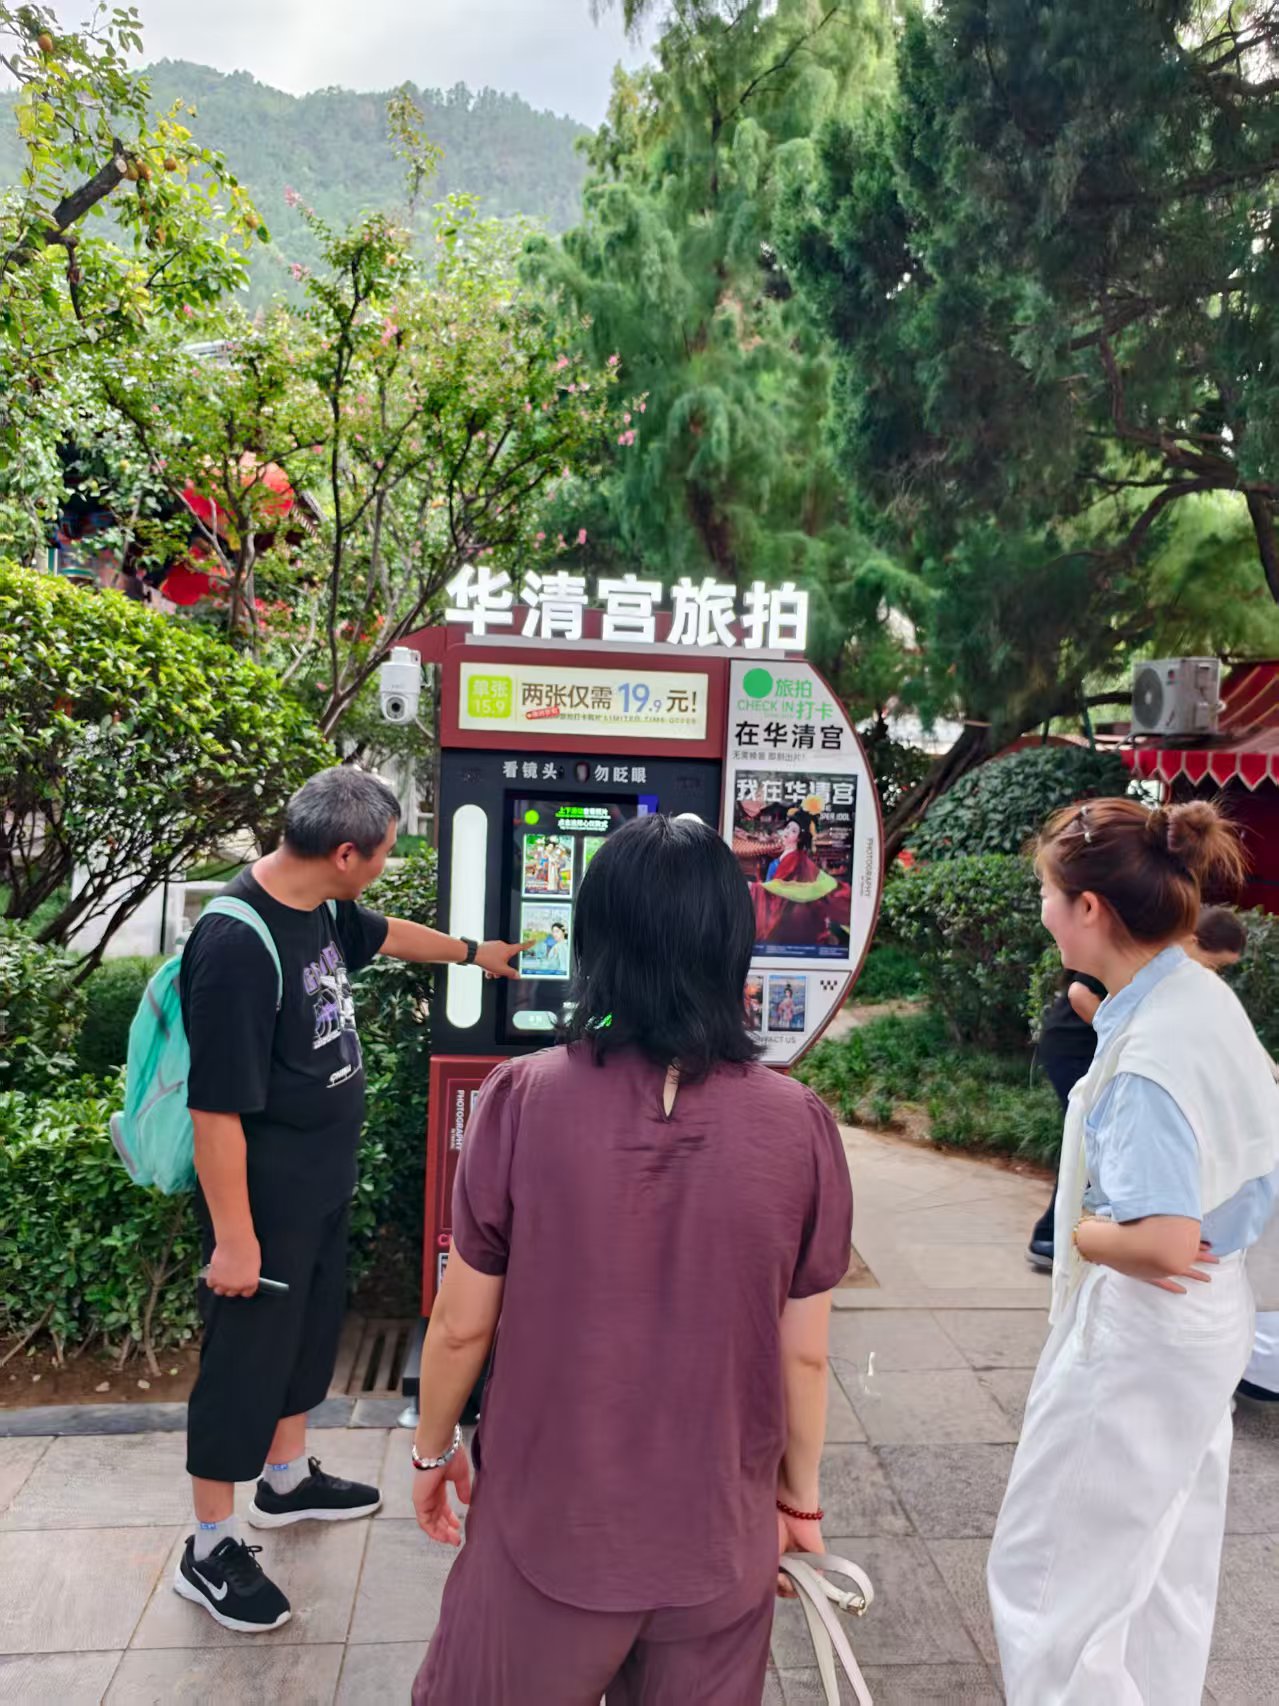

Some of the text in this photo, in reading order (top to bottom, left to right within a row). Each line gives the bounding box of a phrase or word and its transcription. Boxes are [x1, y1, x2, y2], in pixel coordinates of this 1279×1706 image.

[445, 564, 809, 653] 华清宫旅拍
[776, 679, 812, 698] 旅拍
[472, 699, 505, 714] 15.9
[736, 700, 794, 712] CHECK IN
[796, 701, 833, 721] 打卡
[735, 721, 844, 750] 在华清宫
[503, 761, 647, 783] 看镜头 勿眨眼
[864, 837, 874, 897] PHOTOGRAPHY
